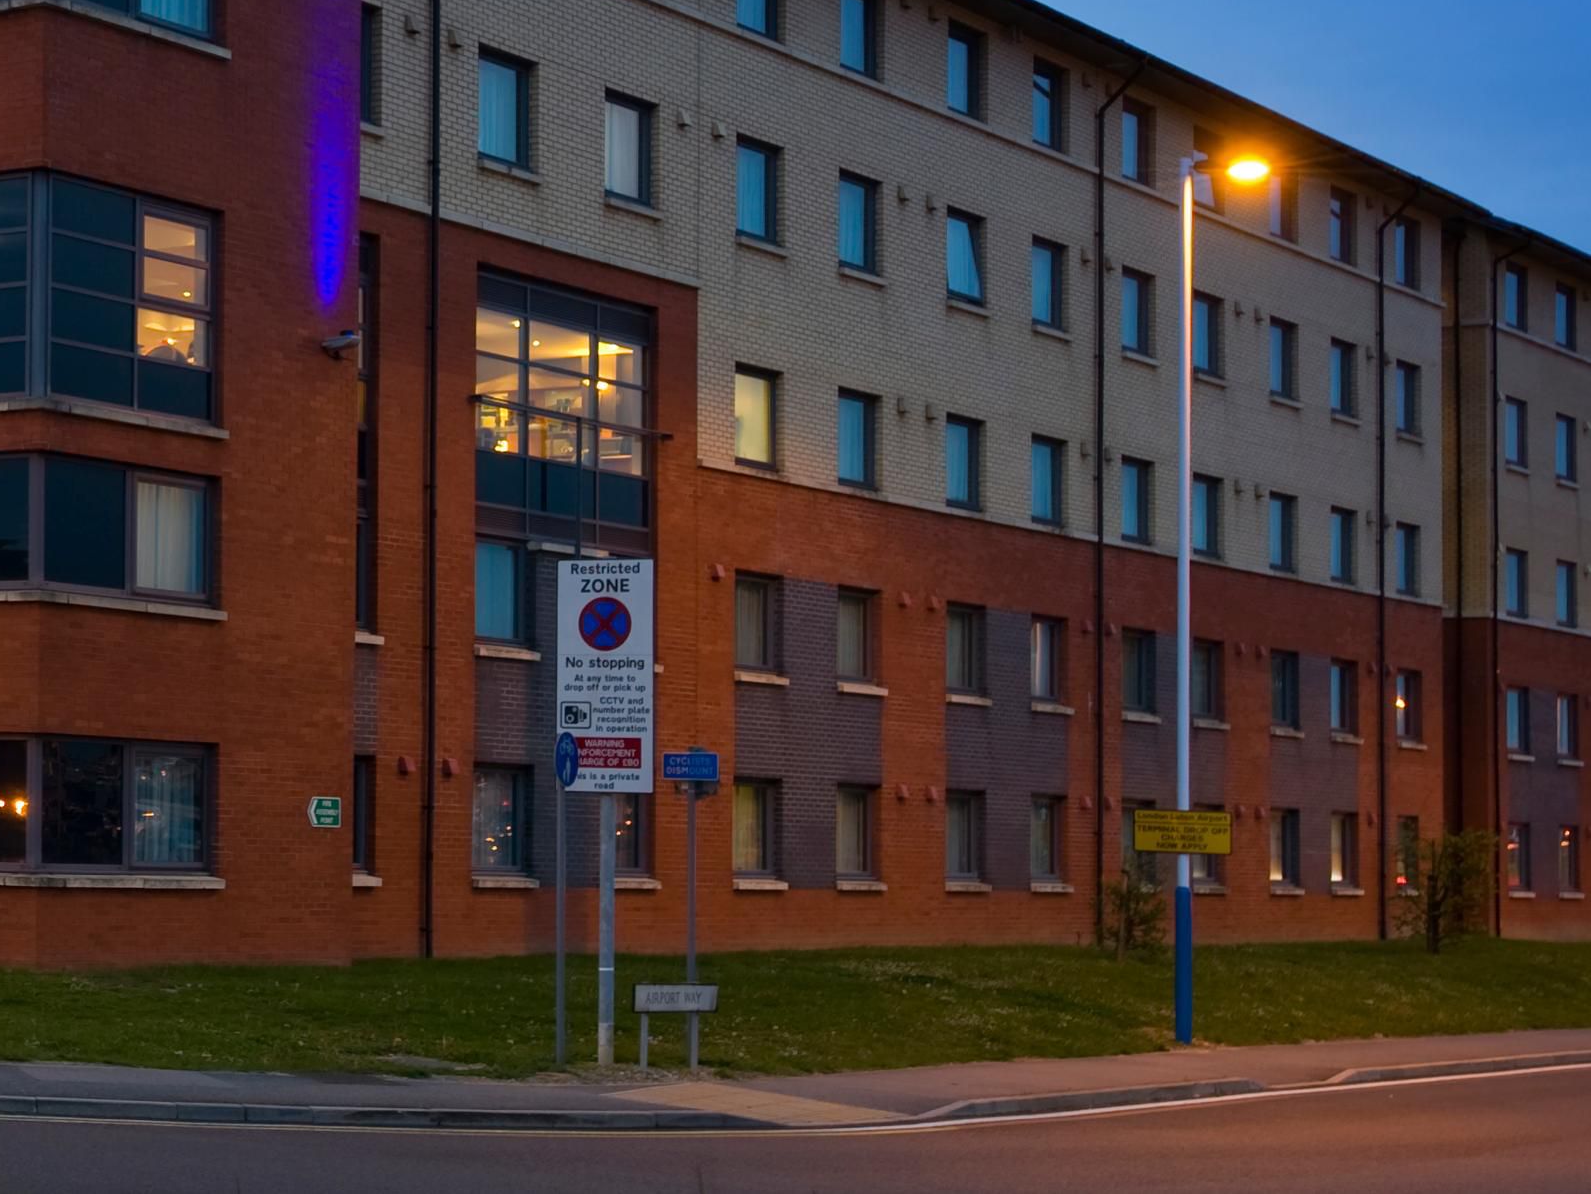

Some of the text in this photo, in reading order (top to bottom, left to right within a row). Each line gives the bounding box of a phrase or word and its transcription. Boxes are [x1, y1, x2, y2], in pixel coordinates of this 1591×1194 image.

[570, 562, 641, 575] Restricted
[580, 578, 630, 593] ZONE
[565, 657, 645, 670] No stopping
[574, 674, 584, 682] At
[587, 675, 601, 683] any
[605, 674, 624, 682] time
[564, 683, 584, 692] drop
[586, 683, 599, 691] off
[613, 684, 631, 692] pick
[634, 685, 646, 693] up
[599, 696, 625, 704] CCTV
[628, 707, 650, 715] plate
[597, 716, 646, 724] recognition
[606, 725, 647, 733] operation
[584, 739, 625, 748] WARNING
[577, 748, 636, 757] NFORCEMENT
[607, 758, 620, 766] OF
[589, 772, 598, 780] is
[609, 772, 640, 781] private
[594, 782, 615, 790] road
[645, 991, 703, 1005] AIRPORT WAY
